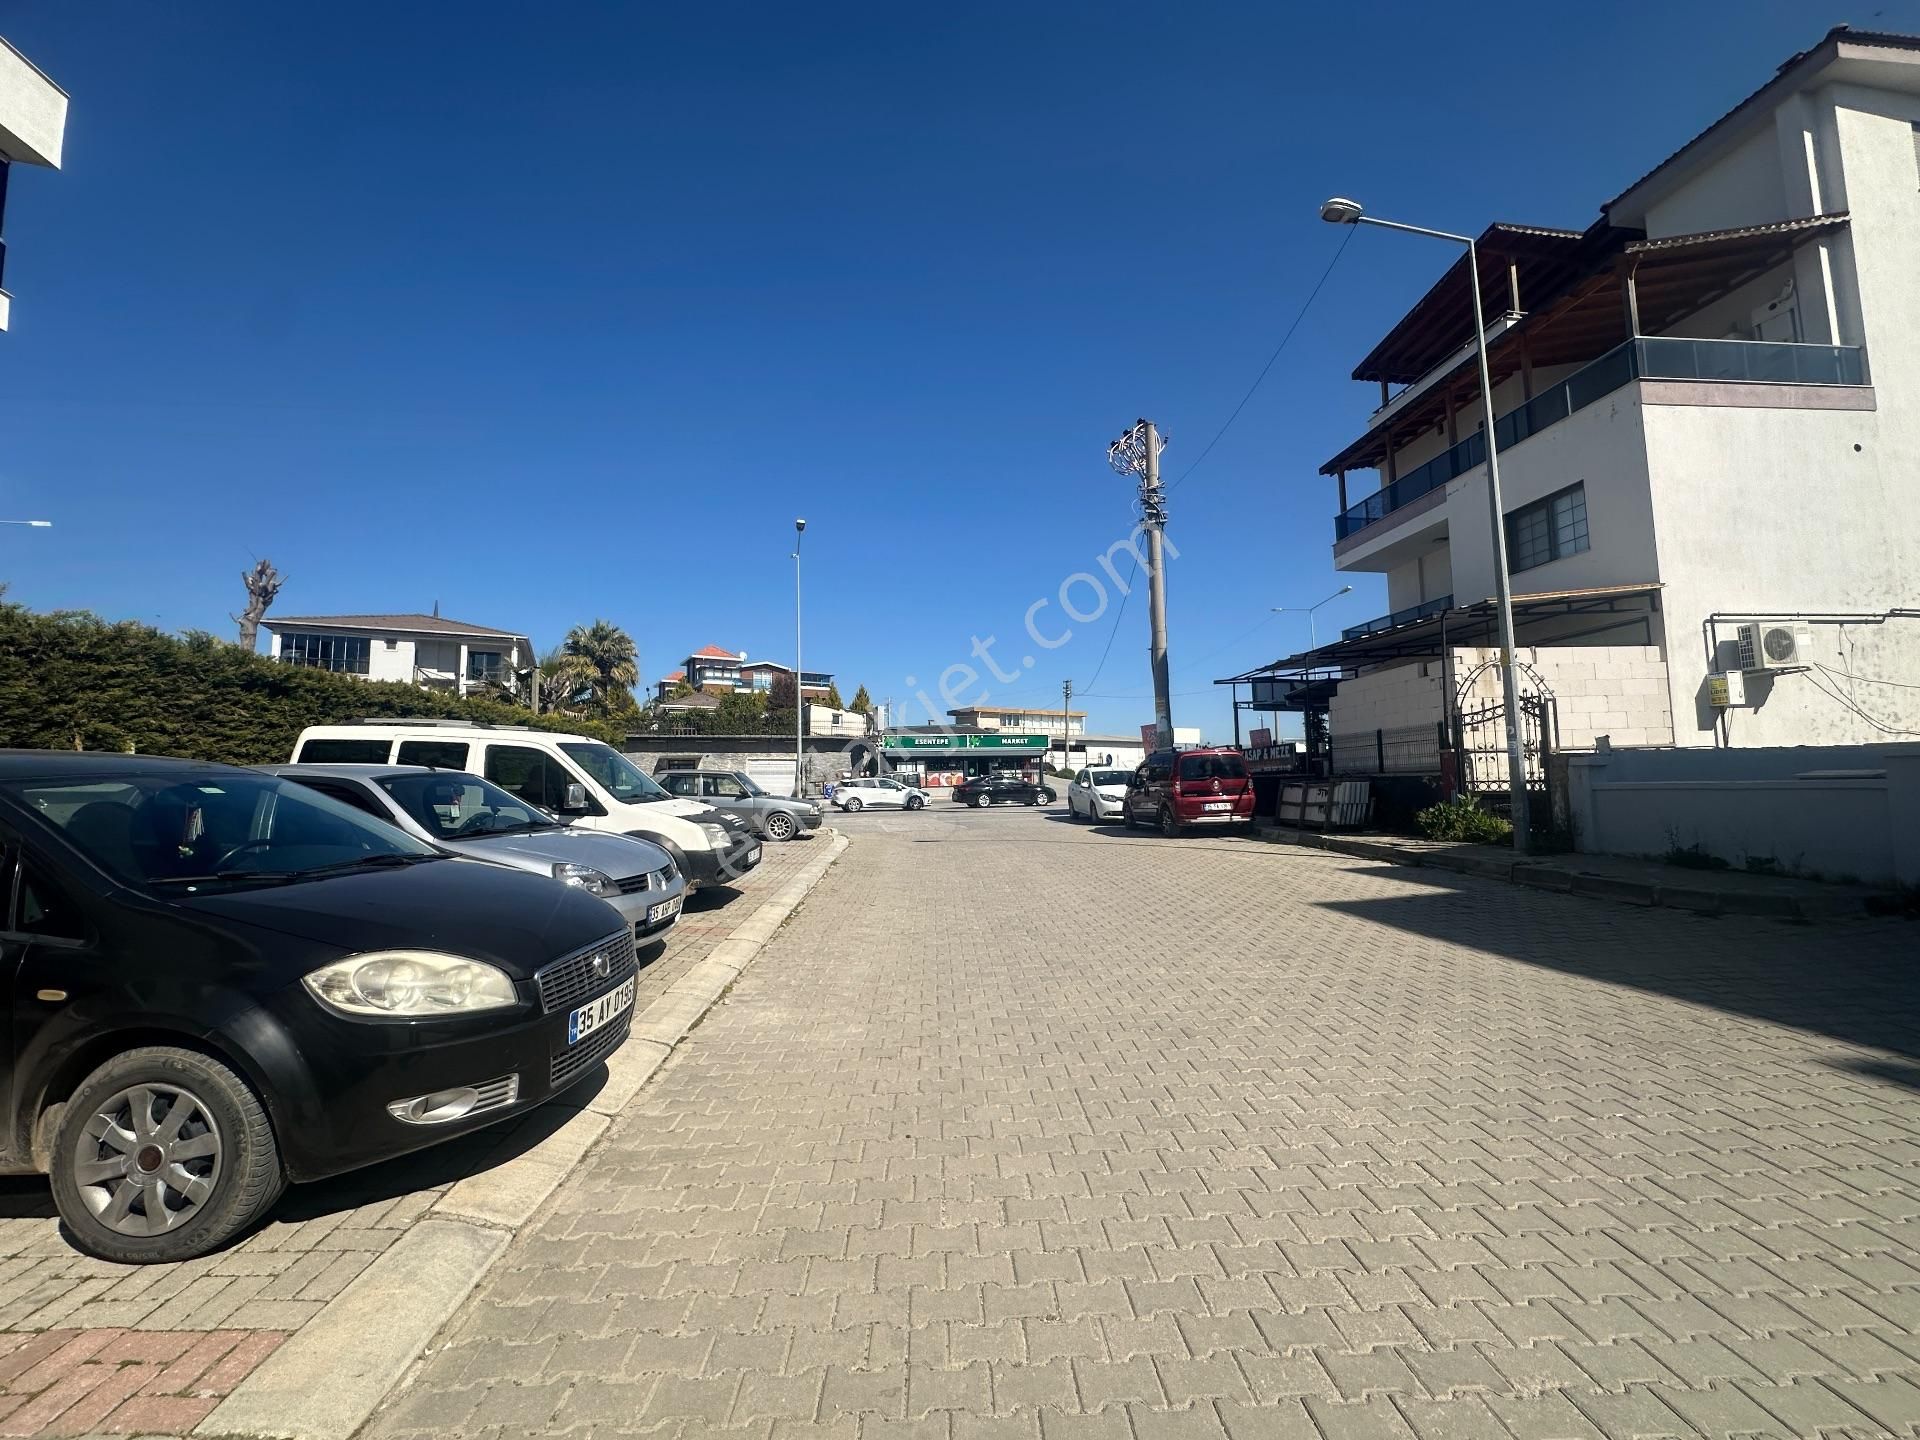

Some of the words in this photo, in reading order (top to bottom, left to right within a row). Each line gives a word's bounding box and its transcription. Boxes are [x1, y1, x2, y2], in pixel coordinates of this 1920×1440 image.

[1270, 745, 1290, 759] MEZE
[579, 1006, 594, 1034] 35
[598, 999, 611, 1025] AY
